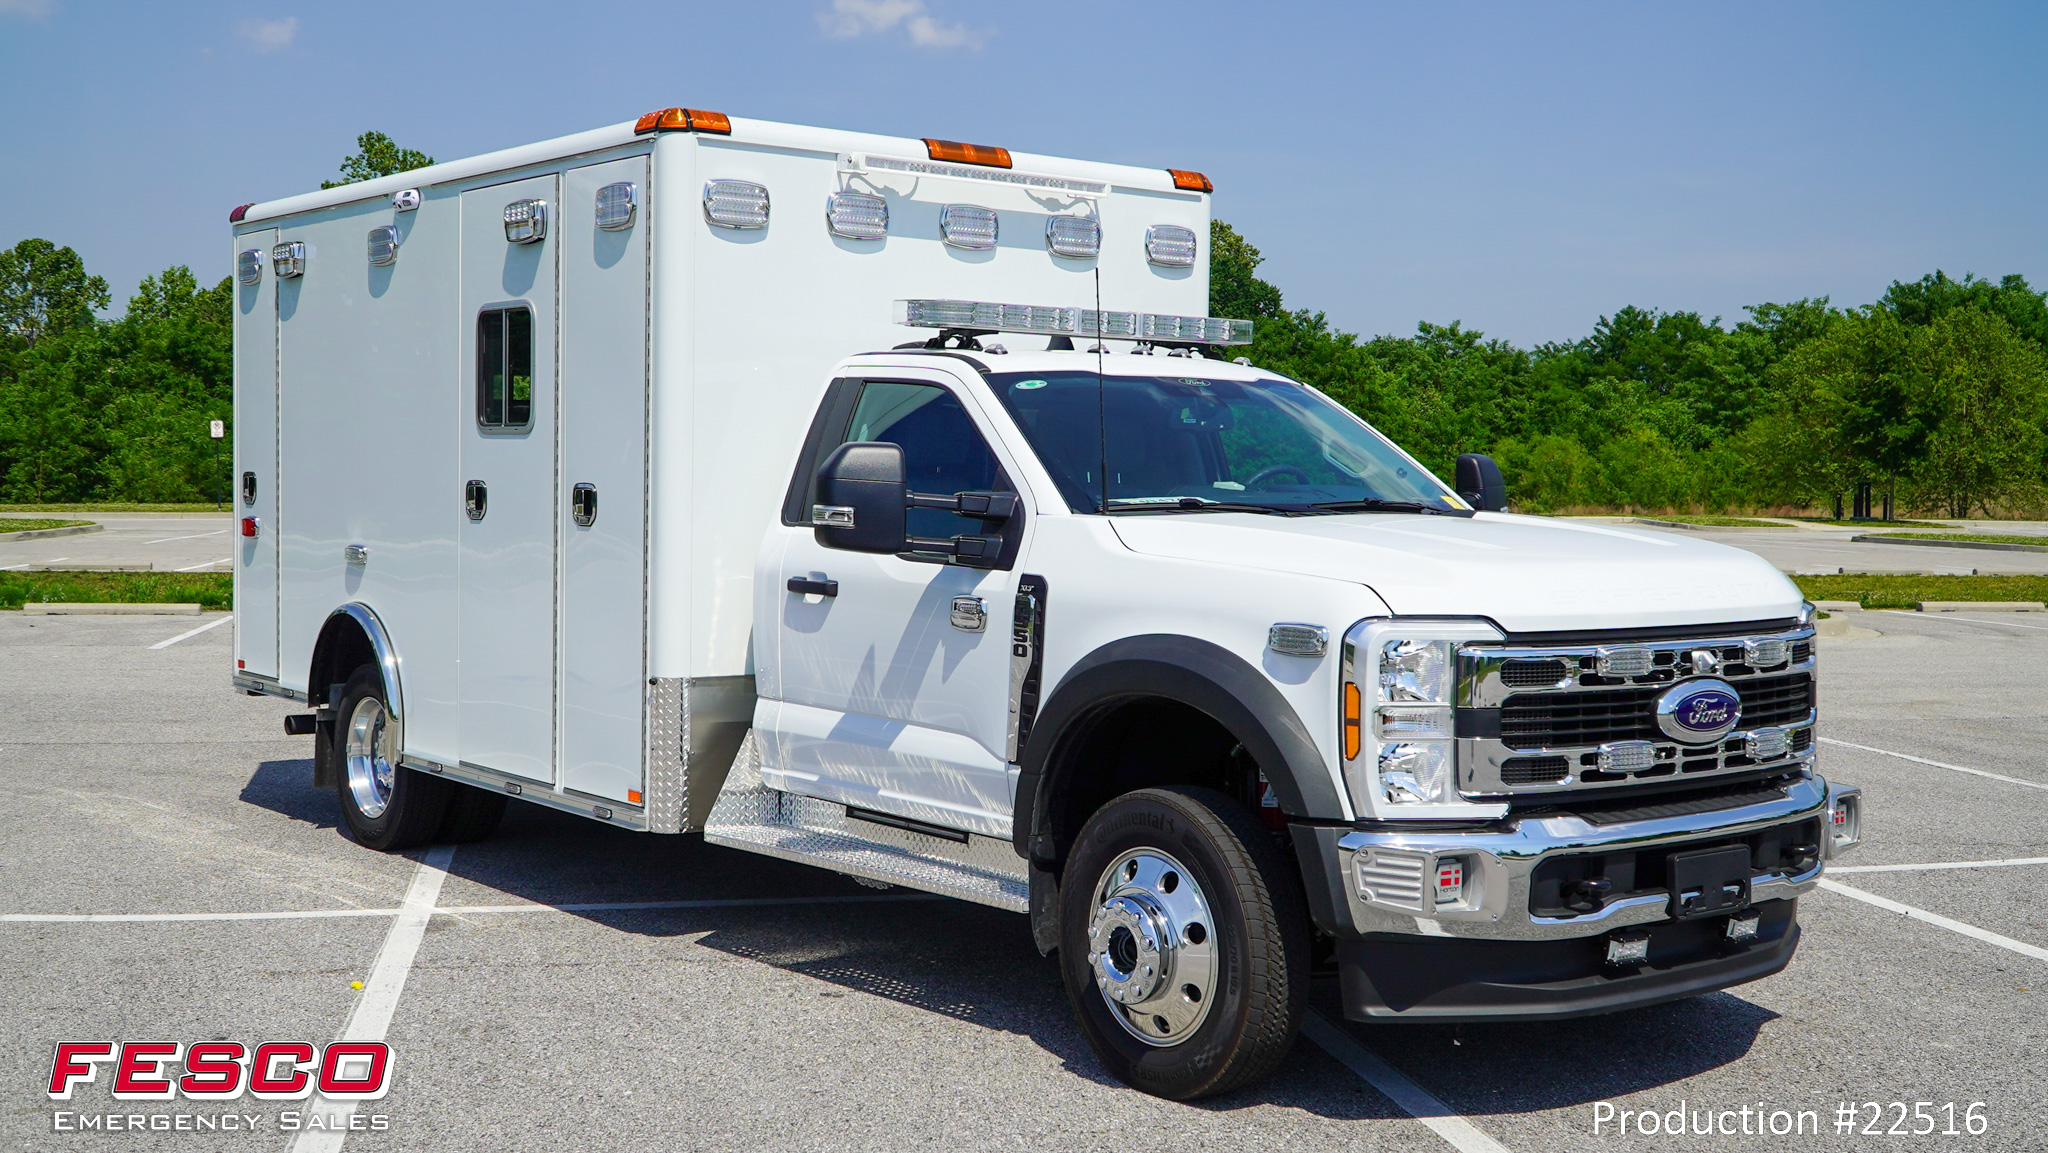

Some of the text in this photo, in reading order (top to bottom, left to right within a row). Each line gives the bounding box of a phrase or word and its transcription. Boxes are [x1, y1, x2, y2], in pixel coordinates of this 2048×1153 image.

[1688, 697, 1728, 725] Ford
[1094, 811, 1165, 843] Continental
[1439, 886, 1460, 894] Horton
